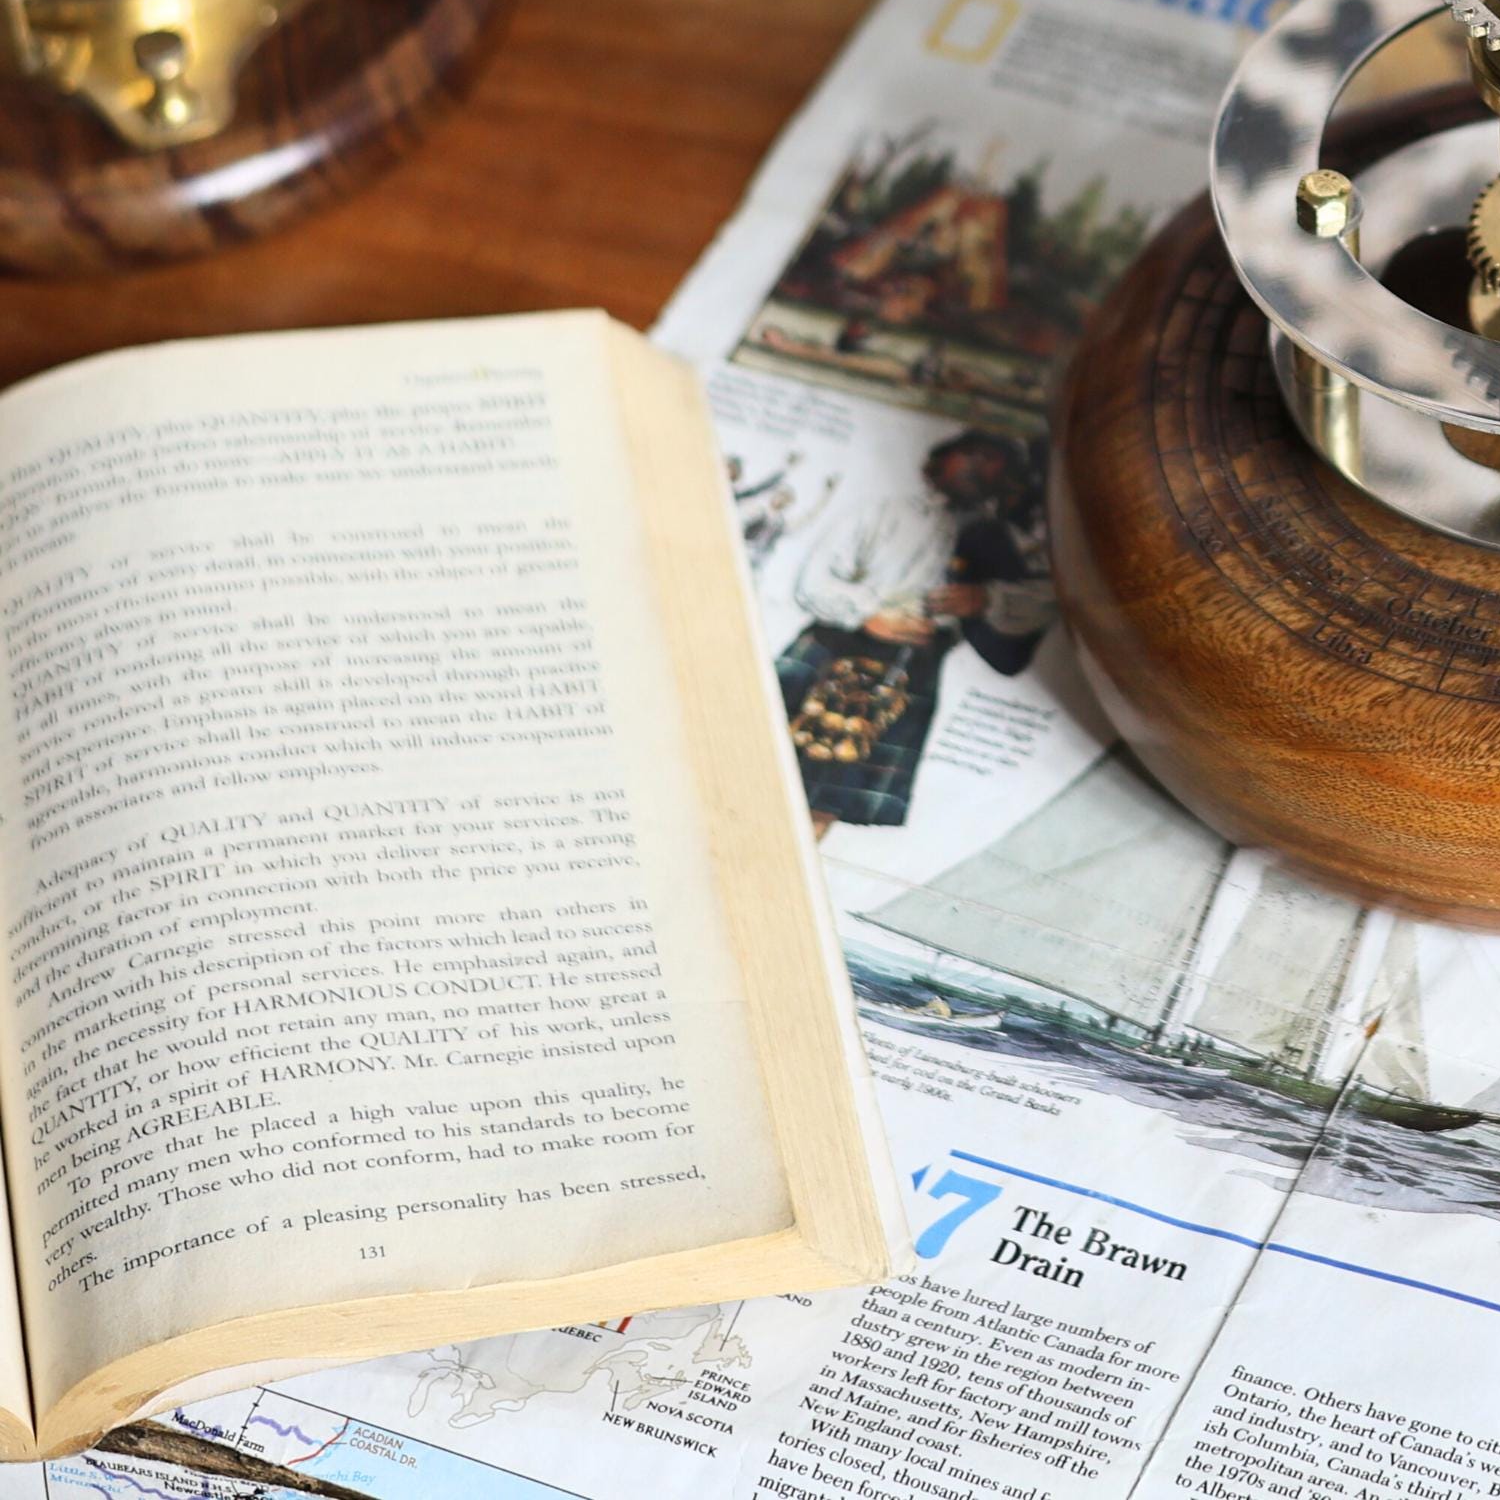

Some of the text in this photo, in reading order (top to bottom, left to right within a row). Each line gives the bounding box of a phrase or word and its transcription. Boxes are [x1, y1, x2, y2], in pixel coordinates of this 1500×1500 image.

[1386, 597, 1492, 642] October
[1311, 624, 1373, 664] Libra
[34, 787, 627, 897] Adequacy of QUALITY and QUANTITY of service is not
[1025, 1098, 1061, 1117] Banks
[36, 1090, 282, 1196] men being AGREEABLE.
[41, 1101, 691, 1250] permitted many men who conformed to his standards to become
[77, 1163, 708, 1295] The importance of a pleasing personality has been stressed,
[916, 1169, 1002, 1259] 7
[358, 1244, 386, 1261] 131
[989, 1236, 1085, 1289] Drain
[1011, 1204, 1189, 1282] The Brawn
[46, 1250, 99, 1293] others.
[867, 1284, 1182, 1384] people from Atlantic Canada for more
[917, 1273, 1157, 1355] have lured large numbers of
[688, 1390, 738, 1413] ISLAND
[694, 1380, 752, 1405] EDWARD
[701, 1369, 752, 1392] PRINCE
[647, 1401, 735, 1435] NOVA SCOTIA
[797, 1394, 963, 1458] New England coast.
[1230, 1363, 1297, 1398] finance.
[1302, 1386, 1364, 1415] Others
[1364, 1400, 1408, 1427] have
[1406, 1418, 1453, 1440] gone
[1454, 1429, 1475, 1447] to
[171, 1411, 266, 1454] MacDonald Farm
[349, 1437, 419, 1469] COASTAL DR.
[353, 1426, 405, 1450] ACADIAN
[602, 1411, 719, 1459] NEW BRUNSWICK
